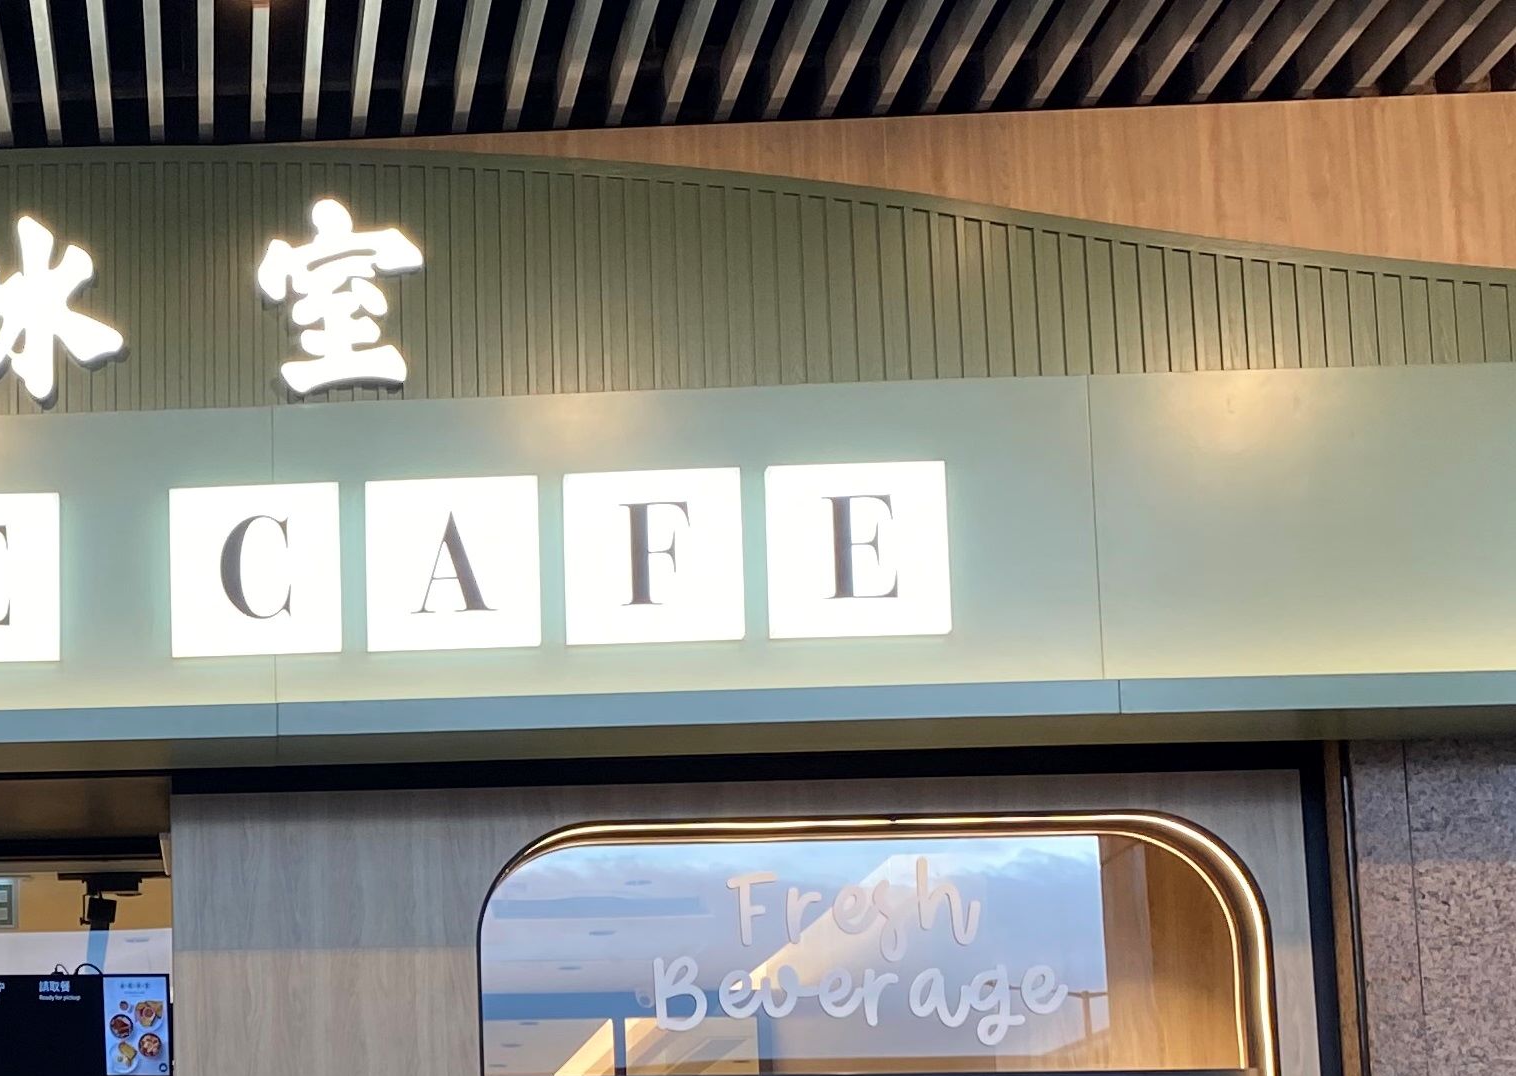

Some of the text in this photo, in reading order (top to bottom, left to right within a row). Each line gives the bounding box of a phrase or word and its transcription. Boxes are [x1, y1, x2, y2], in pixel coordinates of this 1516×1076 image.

[220, 494, 899, 620] CAFE
[726, 856, 981, 962] Fresh
[653, 955, 1069, 1046] Beverage
